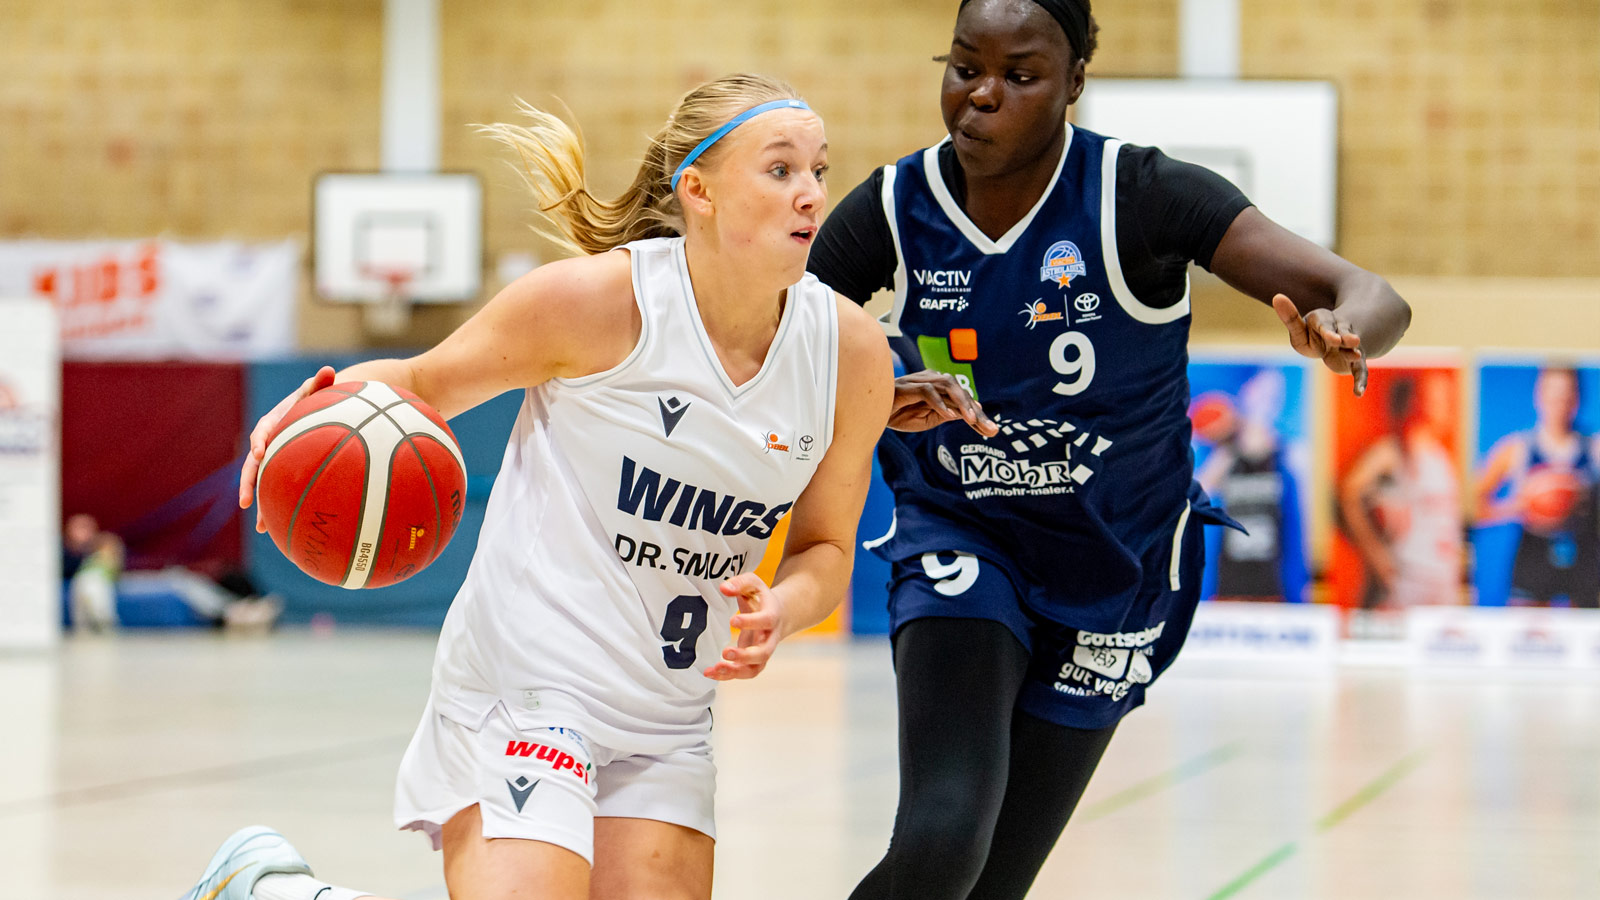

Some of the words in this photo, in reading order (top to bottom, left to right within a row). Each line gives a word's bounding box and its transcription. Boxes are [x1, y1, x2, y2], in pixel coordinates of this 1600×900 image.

[919, 298, 958, 310] CRAFT
[1049, 331, 1095, 396] 9
[960, 444, 1006, 459] GERHARD
[616, 455, 793, 540] WINGS
[354, 542, 372, 572] BG4550
[615, 533, 666, 570] DR.
[921, 550, 979, 596] 9
[660, 595, 708, 669] 9
[1058, 662, 1093, 686] gut
[505, 740, 591, 786] wupsi
